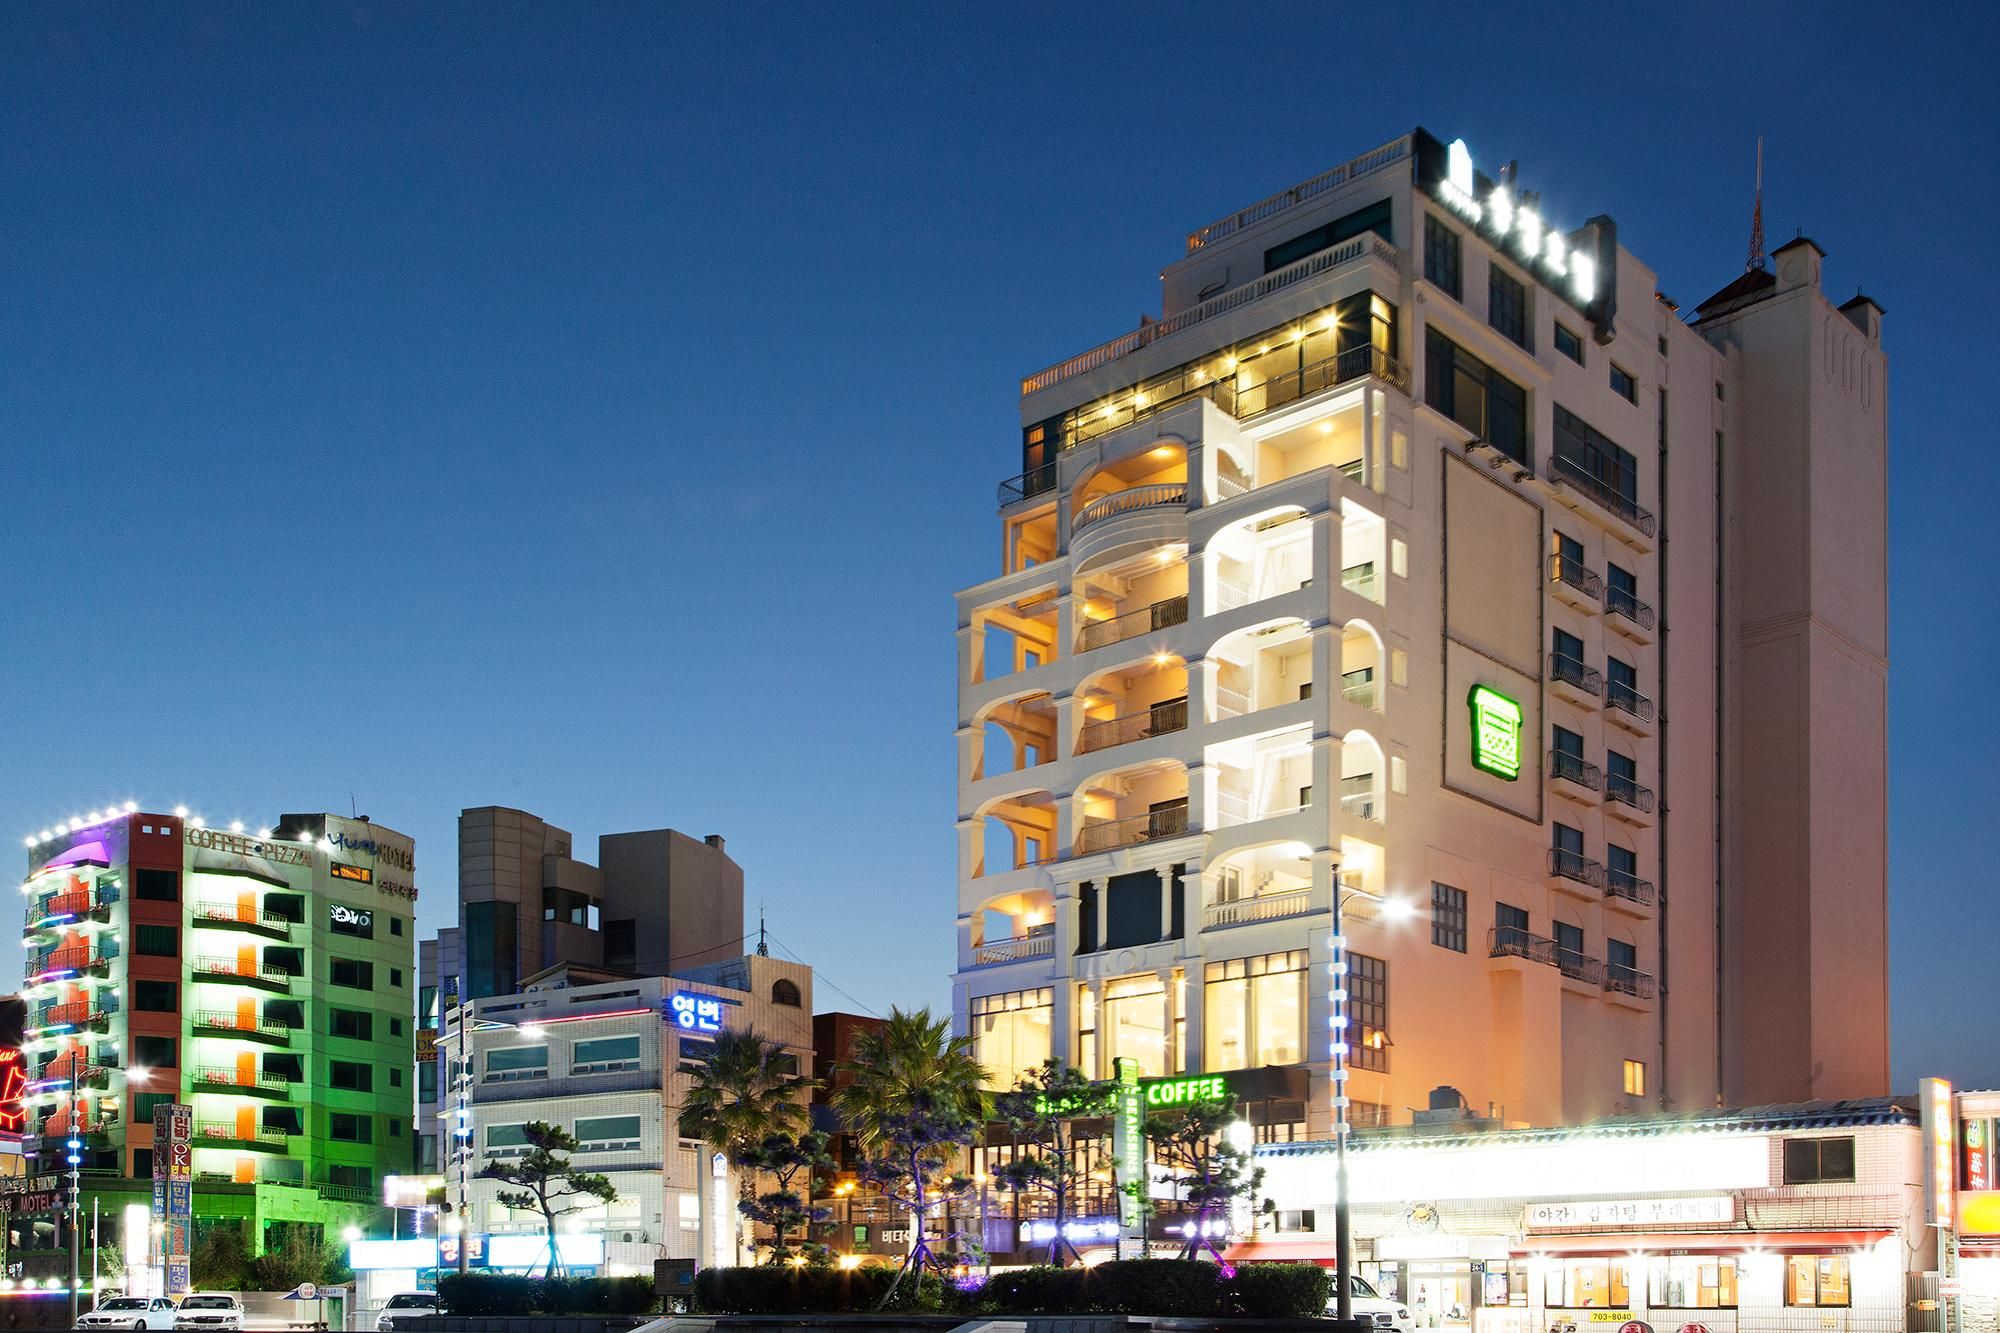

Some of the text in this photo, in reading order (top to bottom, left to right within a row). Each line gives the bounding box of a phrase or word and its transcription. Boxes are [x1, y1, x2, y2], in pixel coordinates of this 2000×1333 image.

[189, 828, 253, 857] COFFEE
[263, 842, 312, 867] PIZZA
[672, 995, 719, 1030] 영변
[1148, 1078, 1225, 1105] COFFEE
[174, 1116, 190, 1140] 민박
[174, 1143, 188, 1165] OK
[21, 1194, 51, 1211] MOTEL
[1532, 1206, 1577, 1223] (야간)
[1588, 1204, 1638, 1222] 감자탕
[1593, 1313, 1632, 1321] 703-8040
